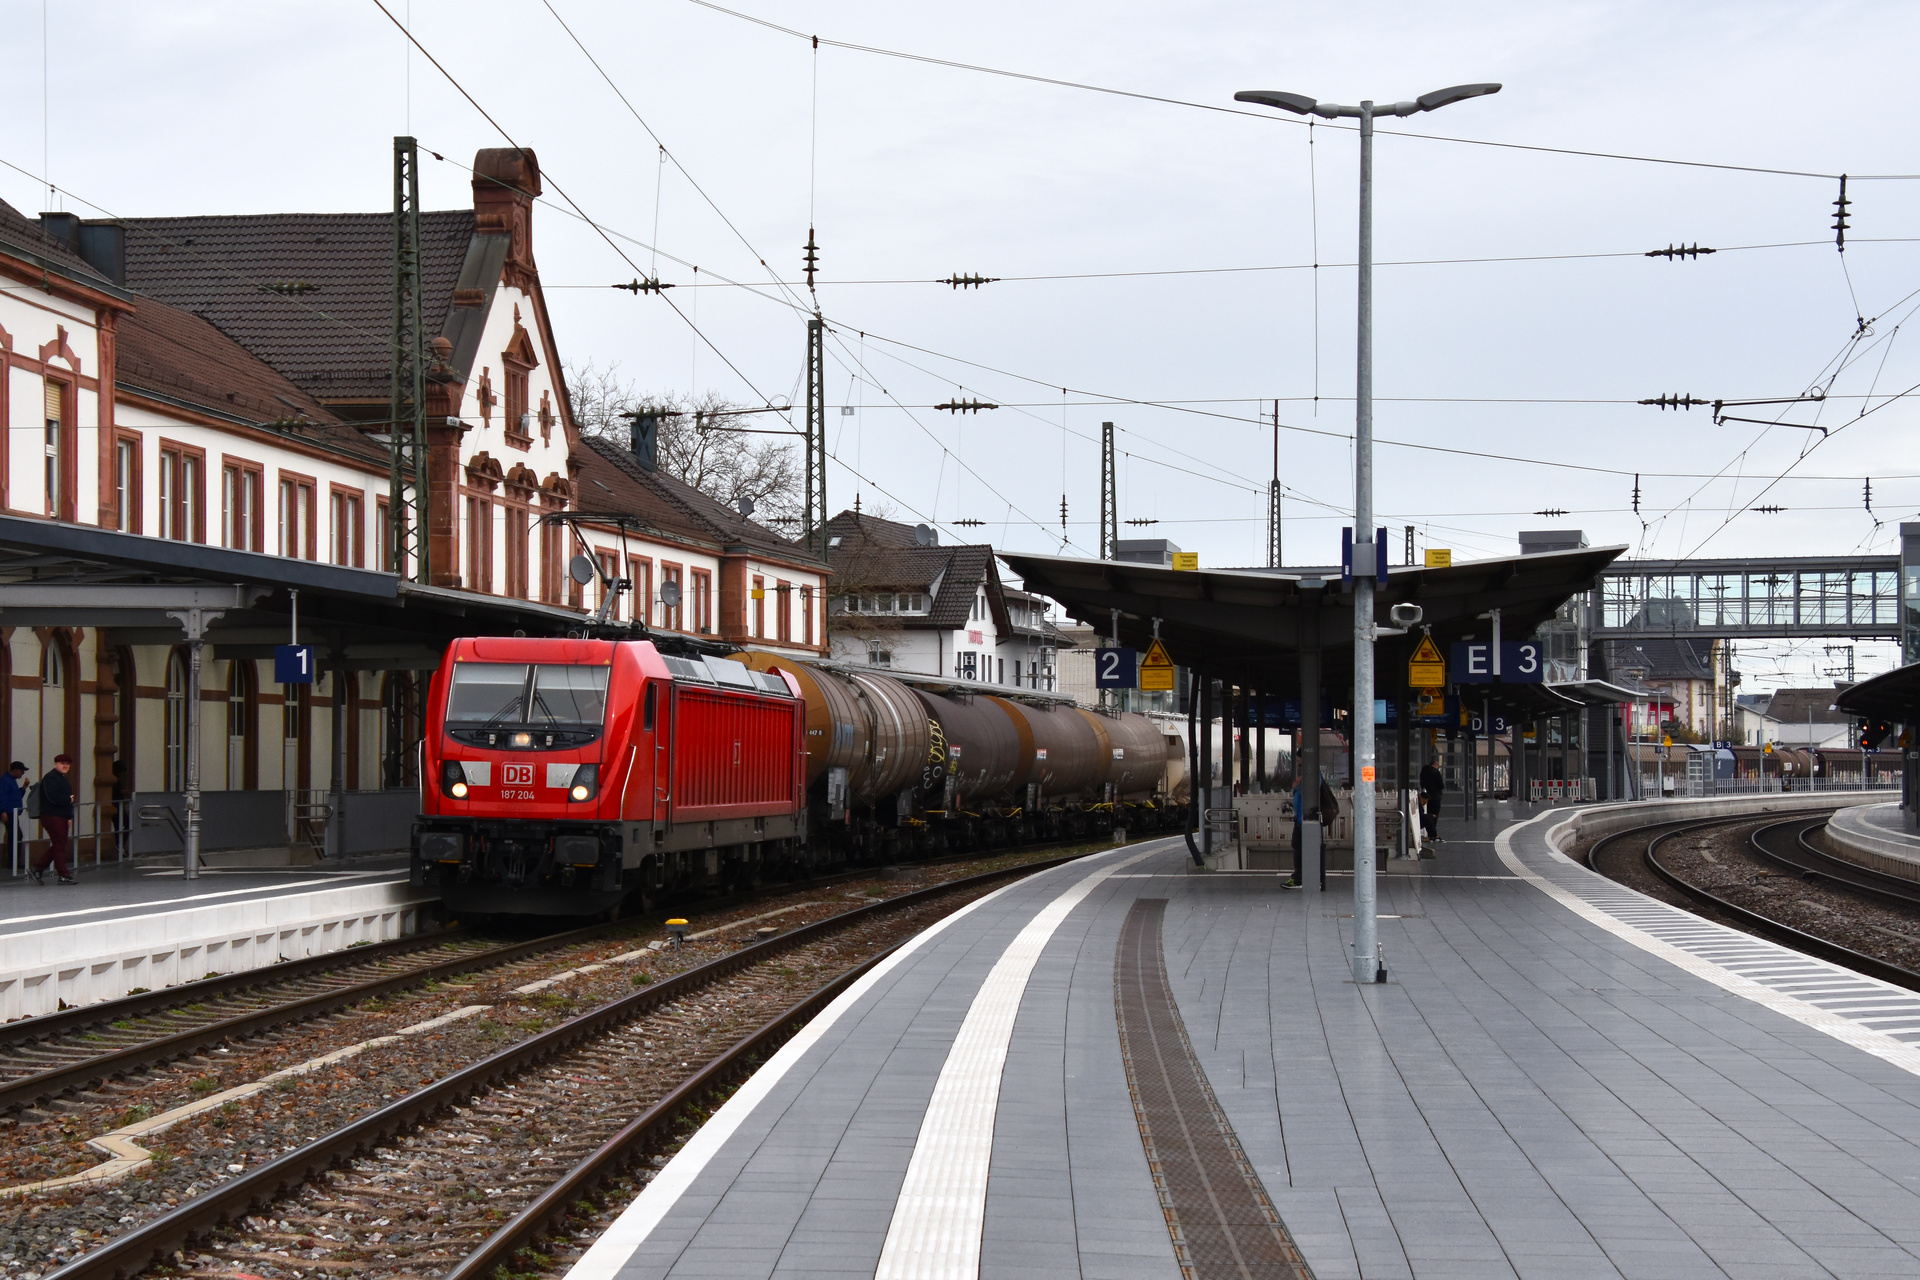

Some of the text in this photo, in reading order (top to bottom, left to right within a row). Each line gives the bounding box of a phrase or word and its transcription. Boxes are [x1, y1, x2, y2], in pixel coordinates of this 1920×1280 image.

[296, 648, 307, 675] 1
[1102, 651, 1120, 680] 2
[1468, 645, 1537, 674] E 3
[1472, 717, 1504, 731] D 3
[506, 767, 531, 783] DB
[501, 789, 535, 800] 187 204
